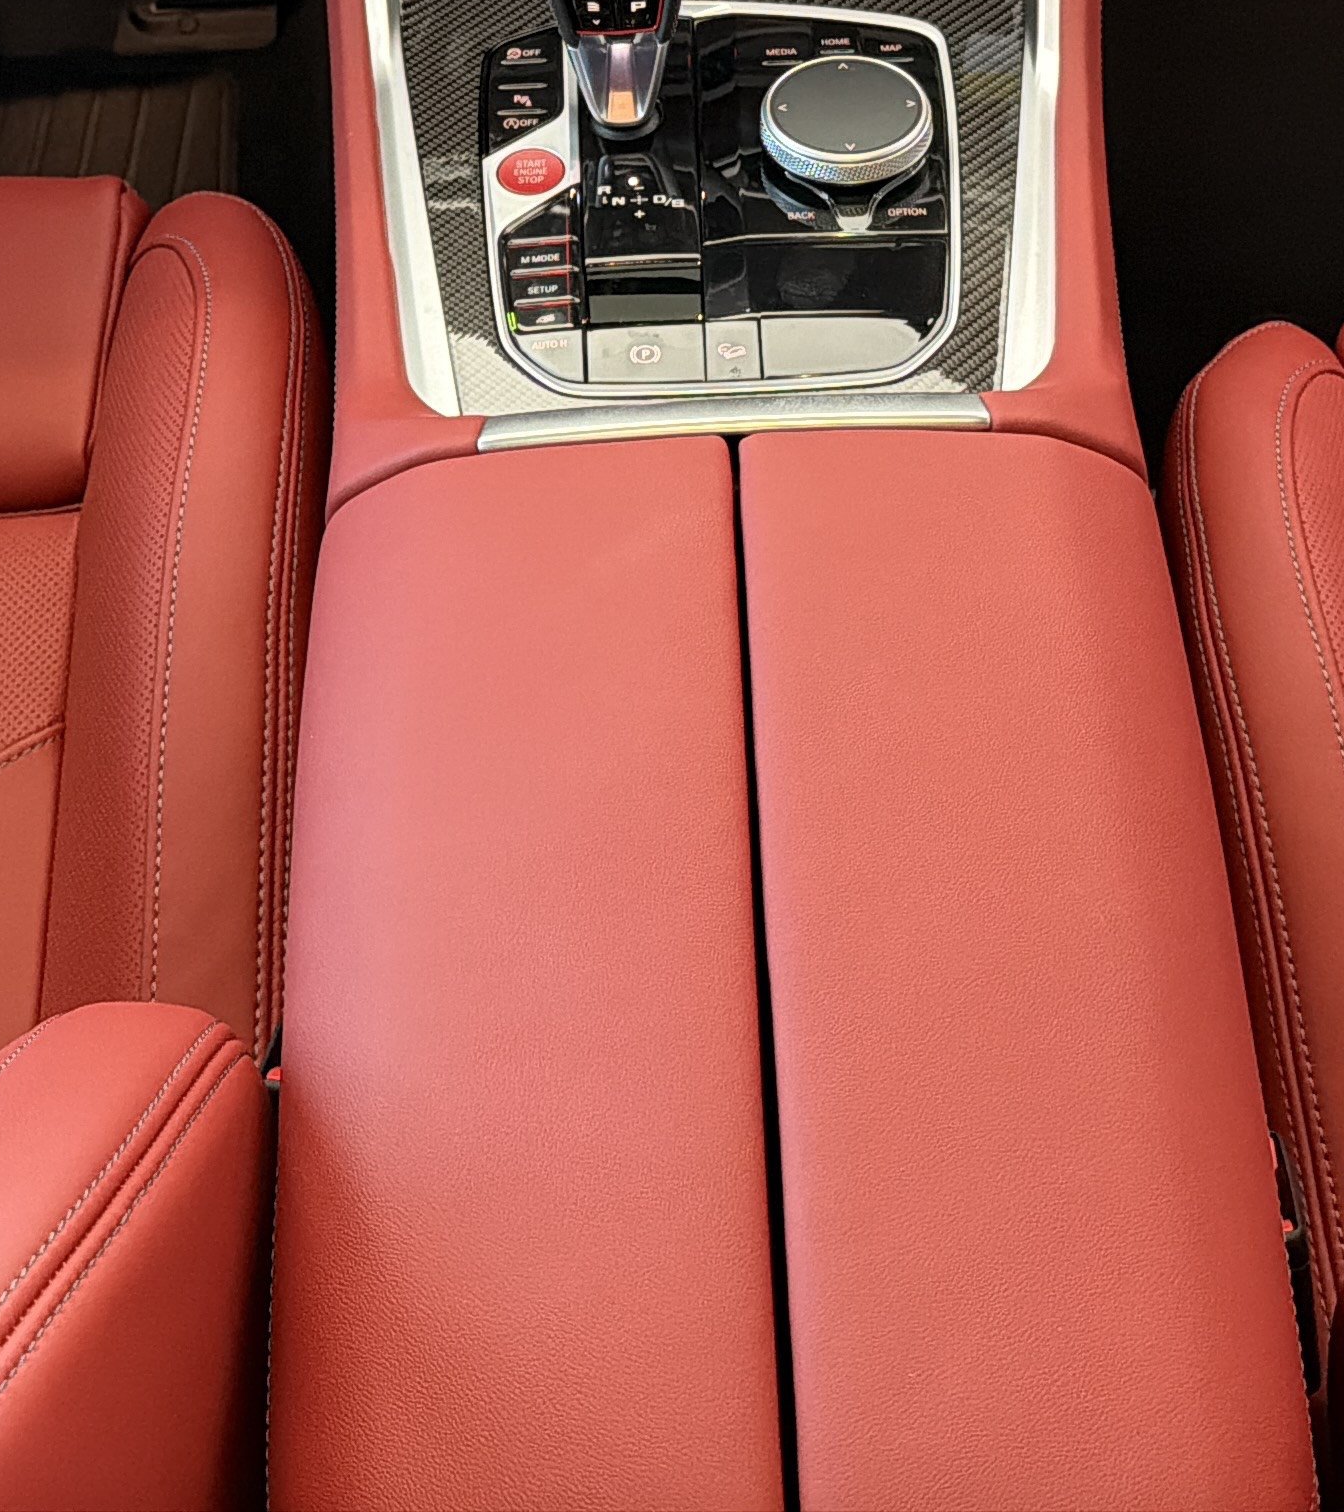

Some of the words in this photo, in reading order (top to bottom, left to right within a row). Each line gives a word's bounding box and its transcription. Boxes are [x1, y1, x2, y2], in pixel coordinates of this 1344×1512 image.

[630, 0, 647, 13] P
[821, 37, 851, 46] HOME
[522, 48, 542, 58] OFF
[765, 47, 798, 57] MEDIA
[880, 44, 902, 52] MAP
[519, 118, 540, 127] OFF
[515, 158, 547, 169] START
[513, 167, 548, 177] ENGINE
[517, 175, 545, 185] STOP
[611, 196, 626, 207] N
[787, 211, 816, 221] BACK
[887, 208, 927, 217] OPTION
[520, 256, 530, 264] M
[531, 253, 560, 263] MODE
[527, 284, 558, 295] SETUP
[531, 340, 555, 350] AUTO
[558, 339, 568, 348] H
